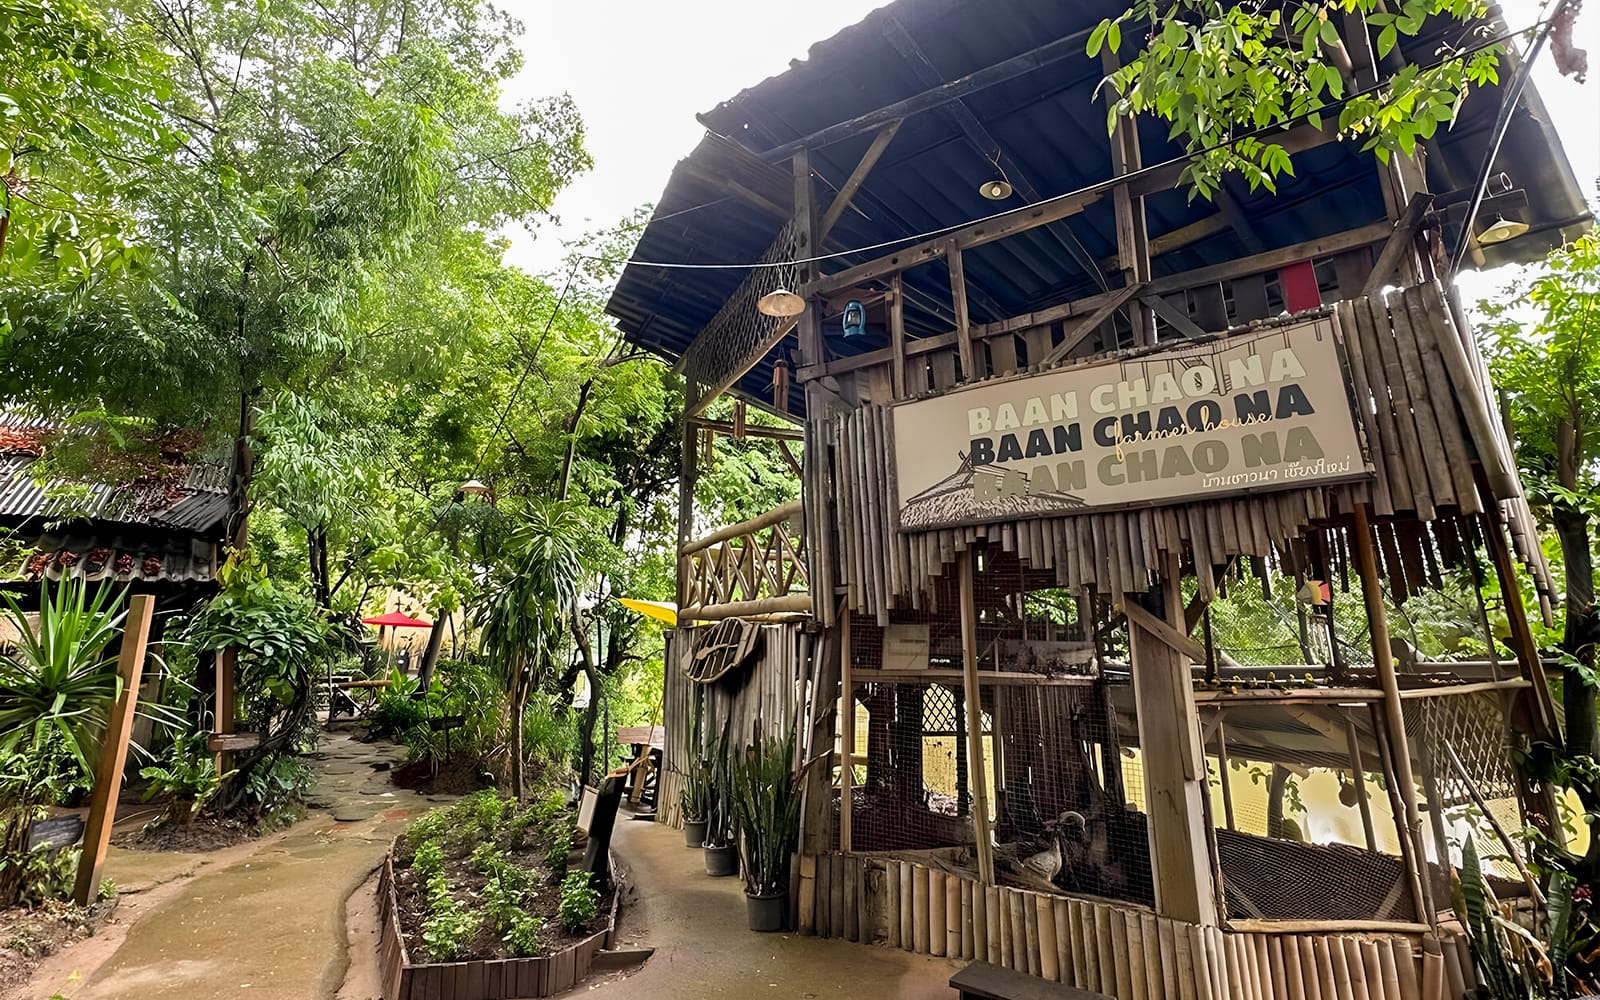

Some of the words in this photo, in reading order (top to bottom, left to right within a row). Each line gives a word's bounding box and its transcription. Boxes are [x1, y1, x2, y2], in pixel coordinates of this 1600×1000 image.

[968, 391, 1078, 435] BAAN
[1090, 366, 1217, 414] CHAO
[1228, 348, 1306, 390] NA
[970, 423, 1083, 466] BAAN
[1093, 400, 1222, 447] CHAO
[1233, 384, 1315, 419] NA
[973, 460, 1087, 500] BAAN
[1097, 440, 1230, 487] CHAO
[1241, 426, 1325, 468] NA
[1114, 420, 1197, 462] farmer
[1201, 405, 1273, 433] house
